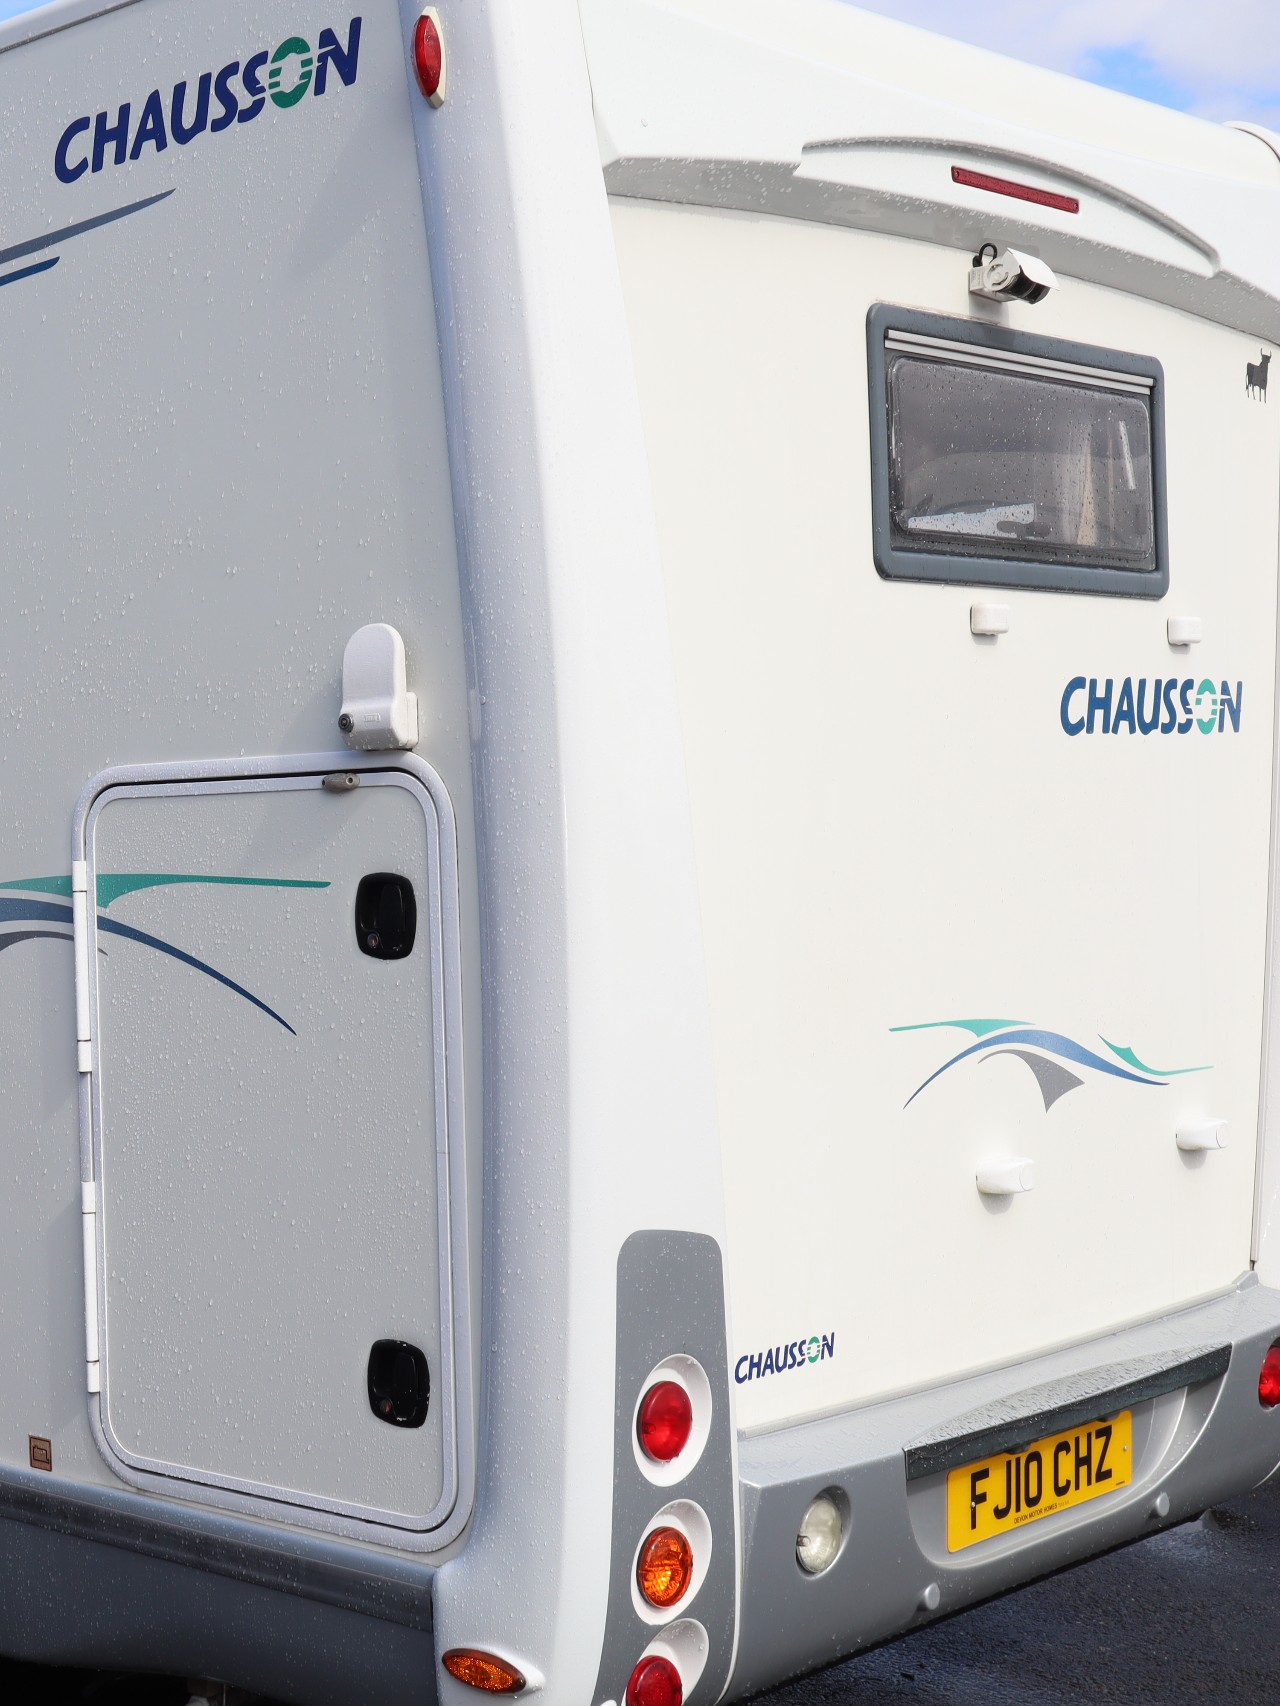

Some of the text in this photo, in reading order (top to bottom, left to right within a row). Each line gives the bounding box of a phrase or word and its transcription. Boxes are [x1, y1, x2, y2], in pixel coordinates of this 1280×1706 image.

[54, 16, 363, 184] CHAUSSON
[1059, 676, 1243, 737] CHAUSSON
[734, 1331, 835, 1384] CHAUSSON
[970, 1424, 1113, 1530] FJ10 CHZ
[1013, 1513, 1028, 1525] DEVON
[1028, 1507, 1043, 1520] MOTOR
[1043, 1502, 1058, 1515] HOMES
